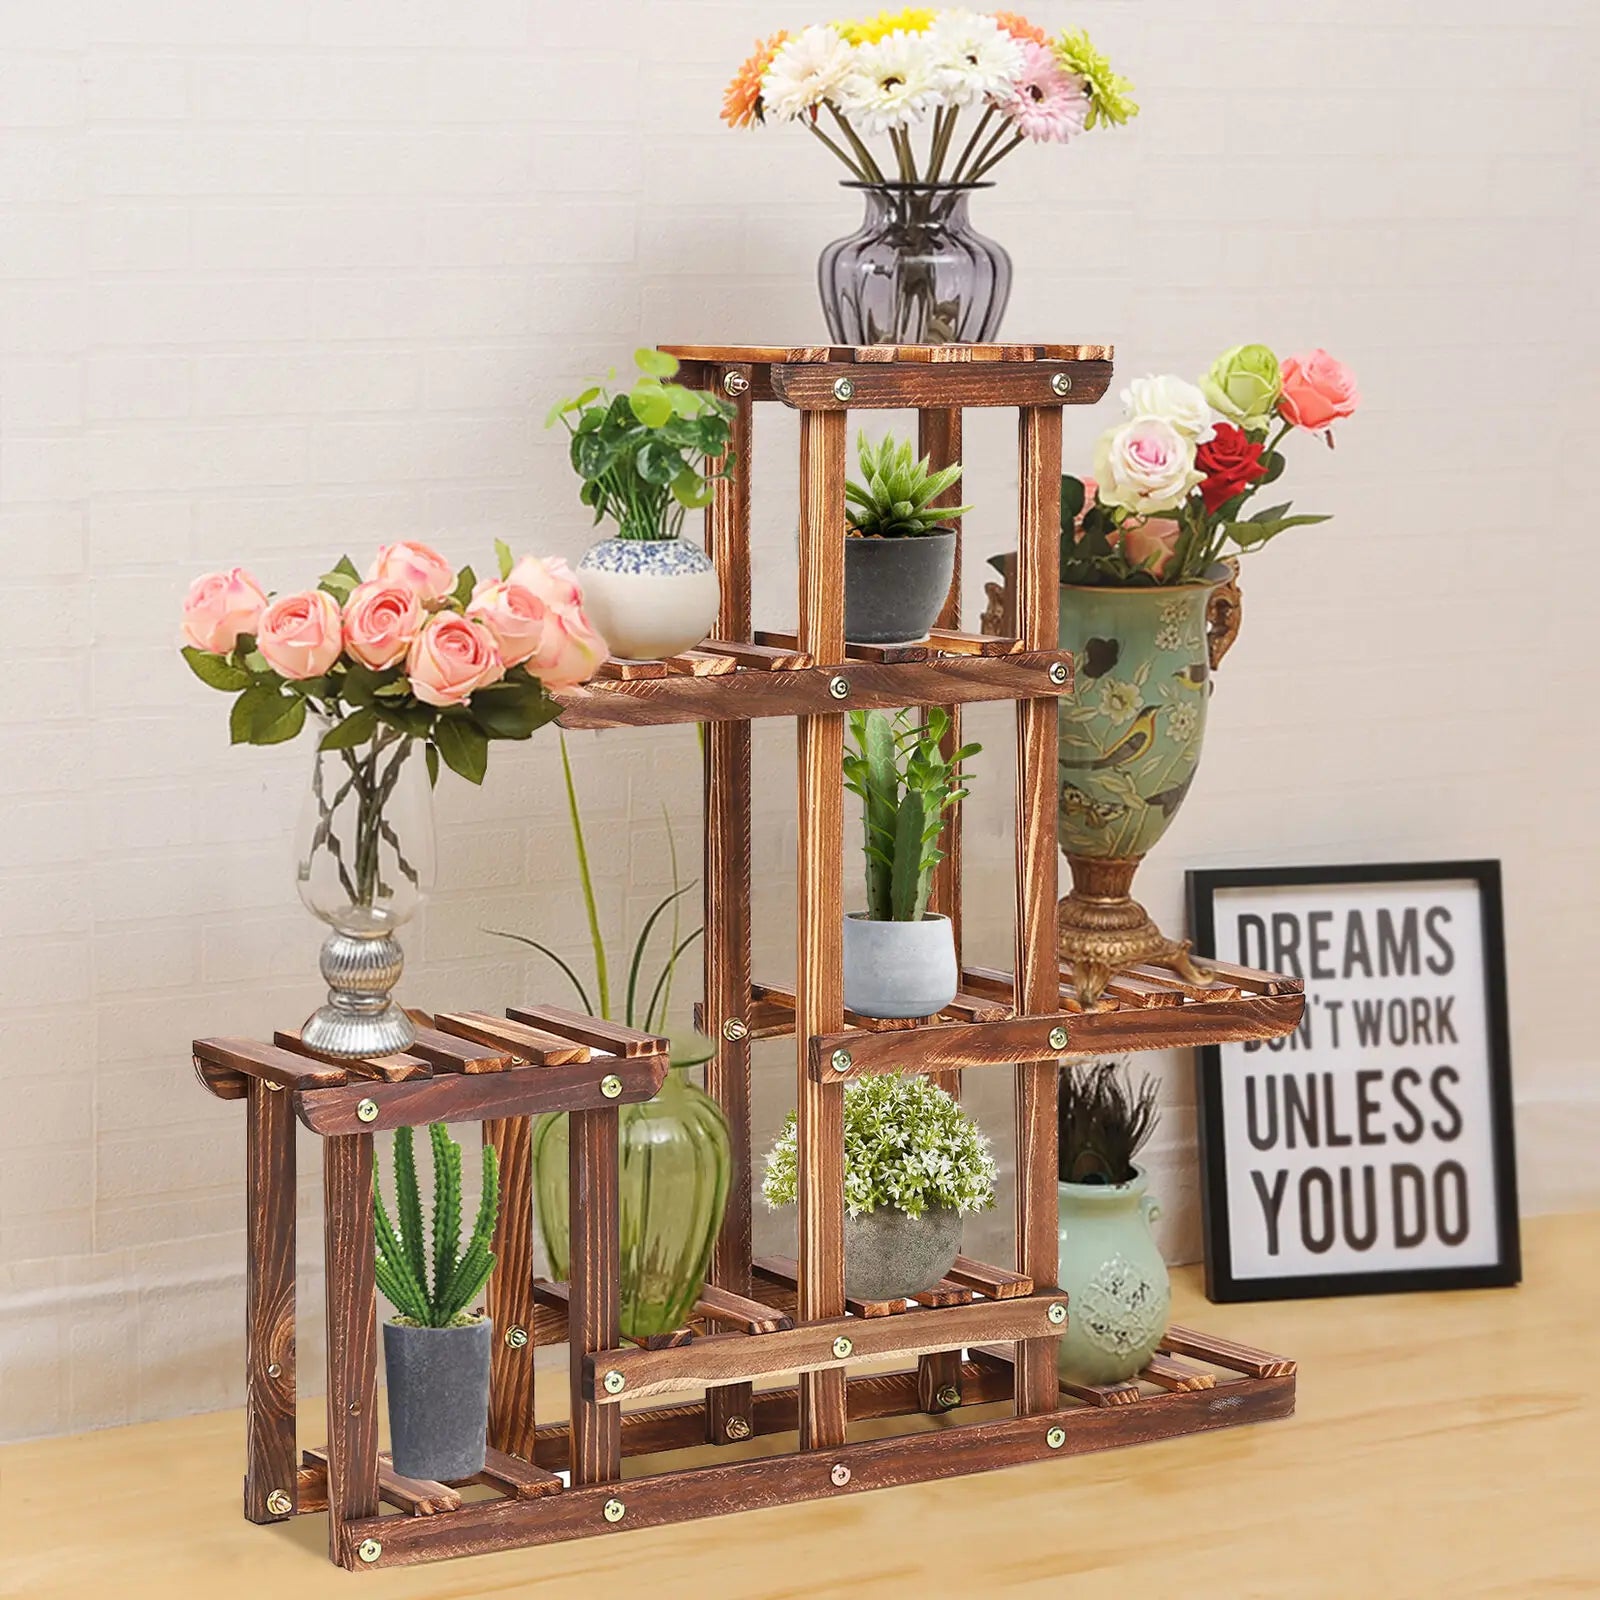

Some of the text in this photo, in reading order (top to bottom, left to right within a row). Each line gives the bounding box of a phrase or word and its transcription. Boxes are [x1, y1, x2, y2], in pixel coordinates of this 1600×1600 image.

[1237, 906, 1455, 980] DREAMS
[1242, 994, 1459, 1053] N'T WORK
[1245, 1066, 1462, 1151] UNLESS
[1250, 1159, 1470, 1256] YOU DO
